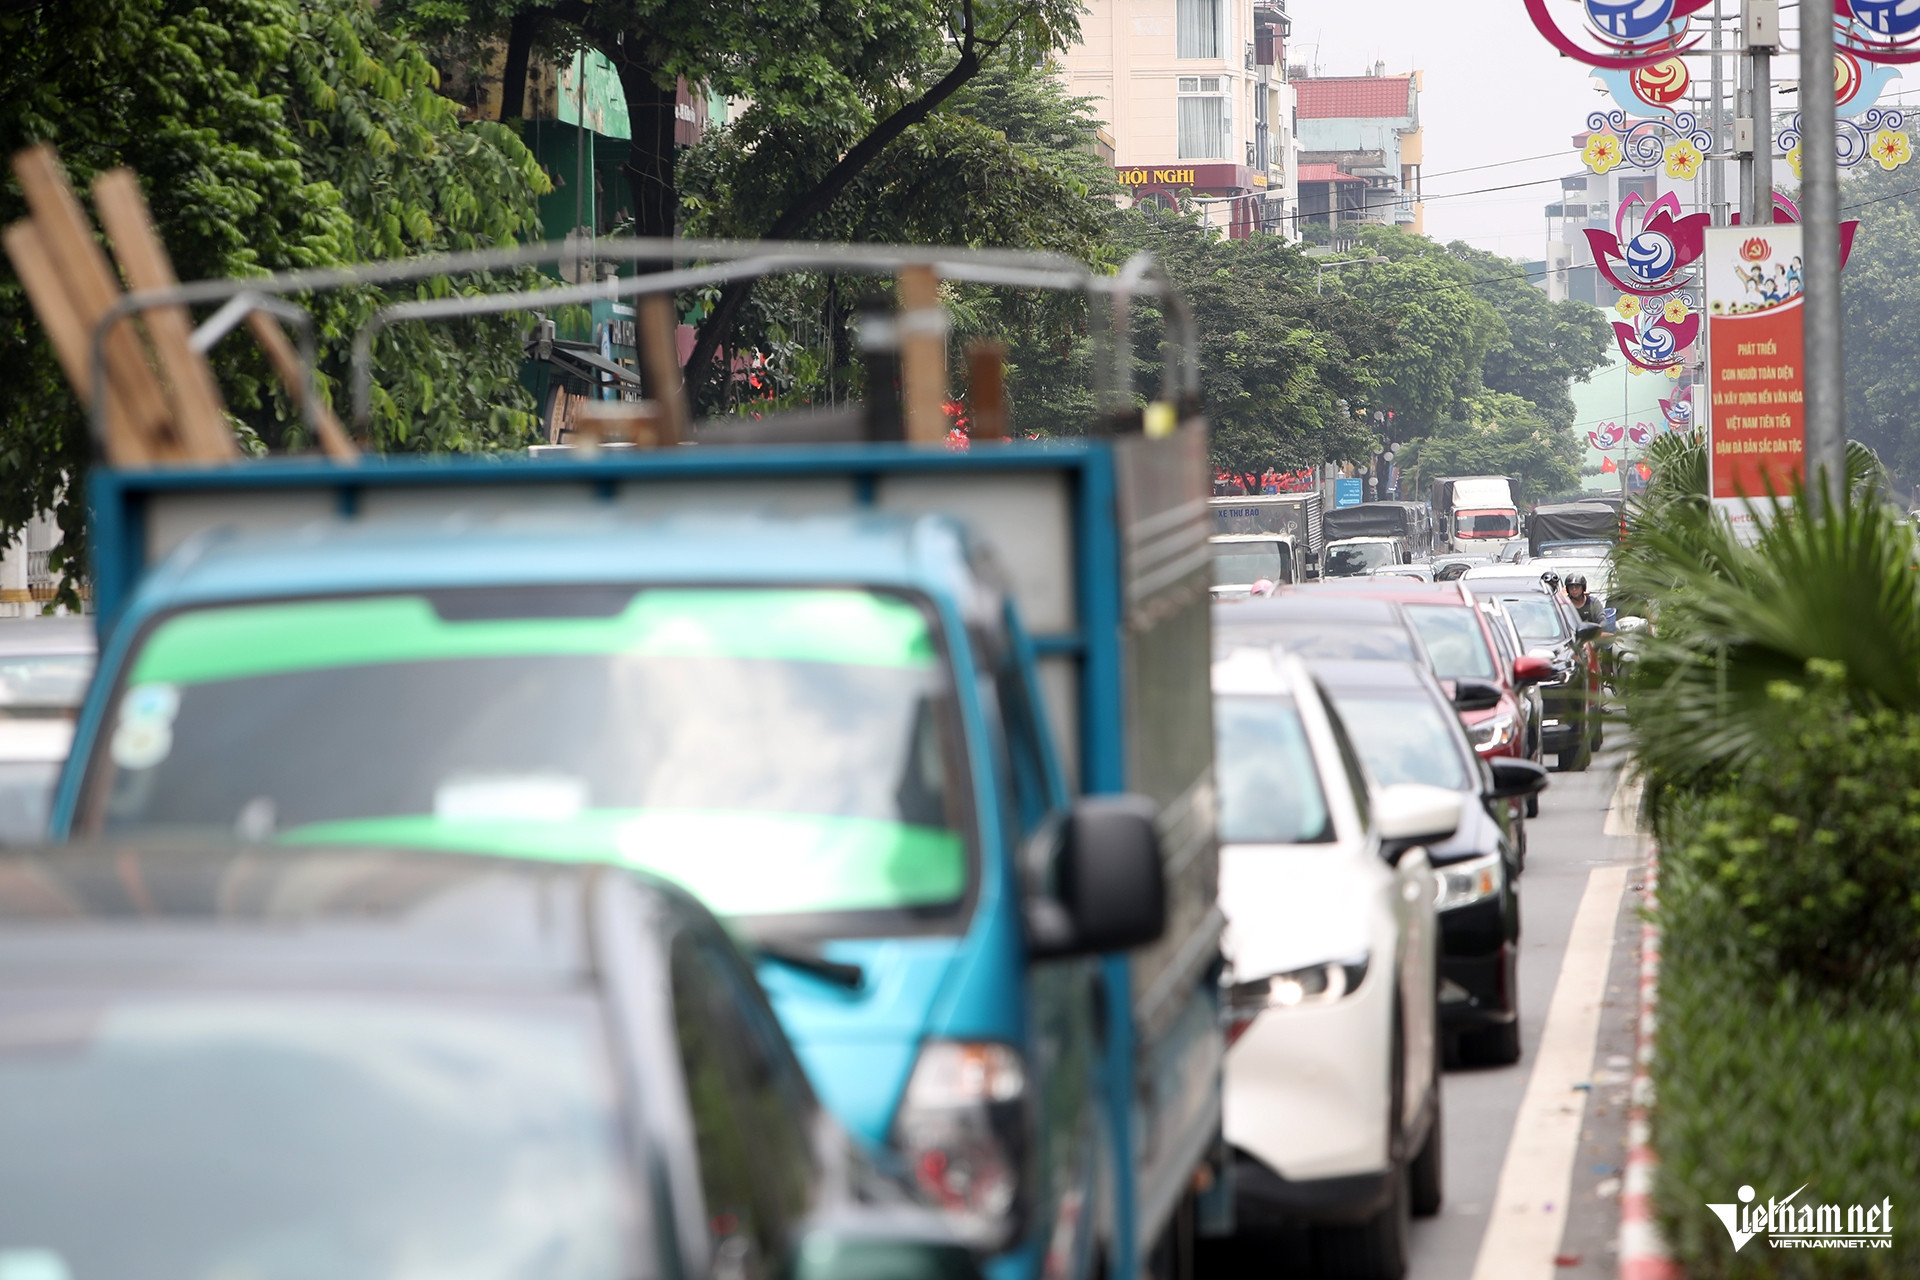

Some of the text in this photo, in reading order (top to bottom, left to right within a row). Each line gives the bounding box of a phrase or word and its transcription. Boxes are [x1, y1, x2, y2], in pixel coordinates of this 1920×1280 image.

[1119, 167, 1195, 188] HỘI NGHỊ
[1737, 338, 1777, 356] PHÁT TRIỂN
[1722, 368, 1736, 381] CON
[1758, 365, 1776, 380] TOÀN
[1726, 412, 1791, 431] VIỆT NAM TIÊN TIẾN
[1788, 438, 1802, 454] TỘC
[1218, 509, 1227, 518] XE
[1229, 508, 1243, 518] THƯ
